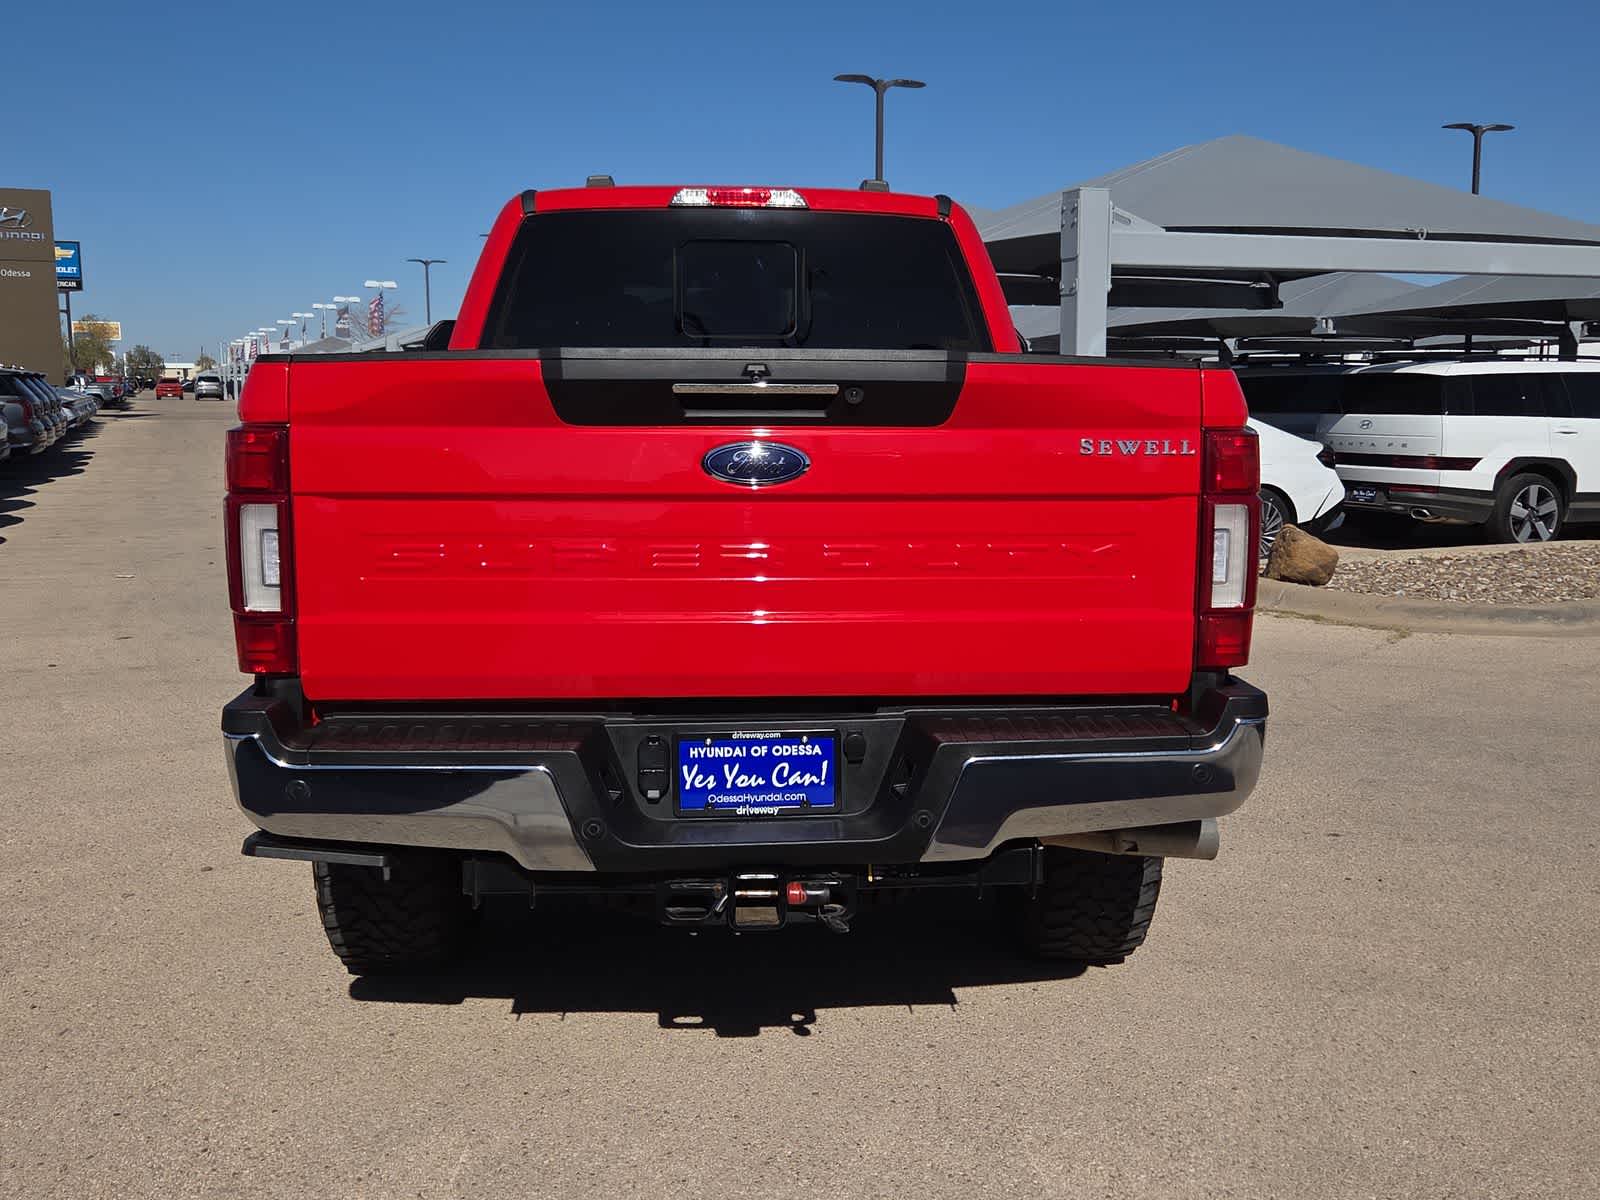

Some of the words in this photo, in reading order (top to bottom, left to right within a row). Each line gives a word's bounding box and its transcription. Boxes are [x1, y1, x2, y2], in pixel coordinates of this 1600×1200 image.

[0, 268, 31, 277] Odessa
[1079, 438, 1196, 455] SEWELL
[732, 731, 781, 740] driveway.com
[689, 746, 747, 758] HYUNDAI
[750, 746, 768, 757] OF
[771, 745, 822, 756] ODESSA
[682, 764, 717, 790] Yes
[723, 762, 765, 789] You
[771, 760, 828, 788] Can!
[707, 791, 807, 804] OdessaHyundai.com
[736, 805, 780, 815] driveway
